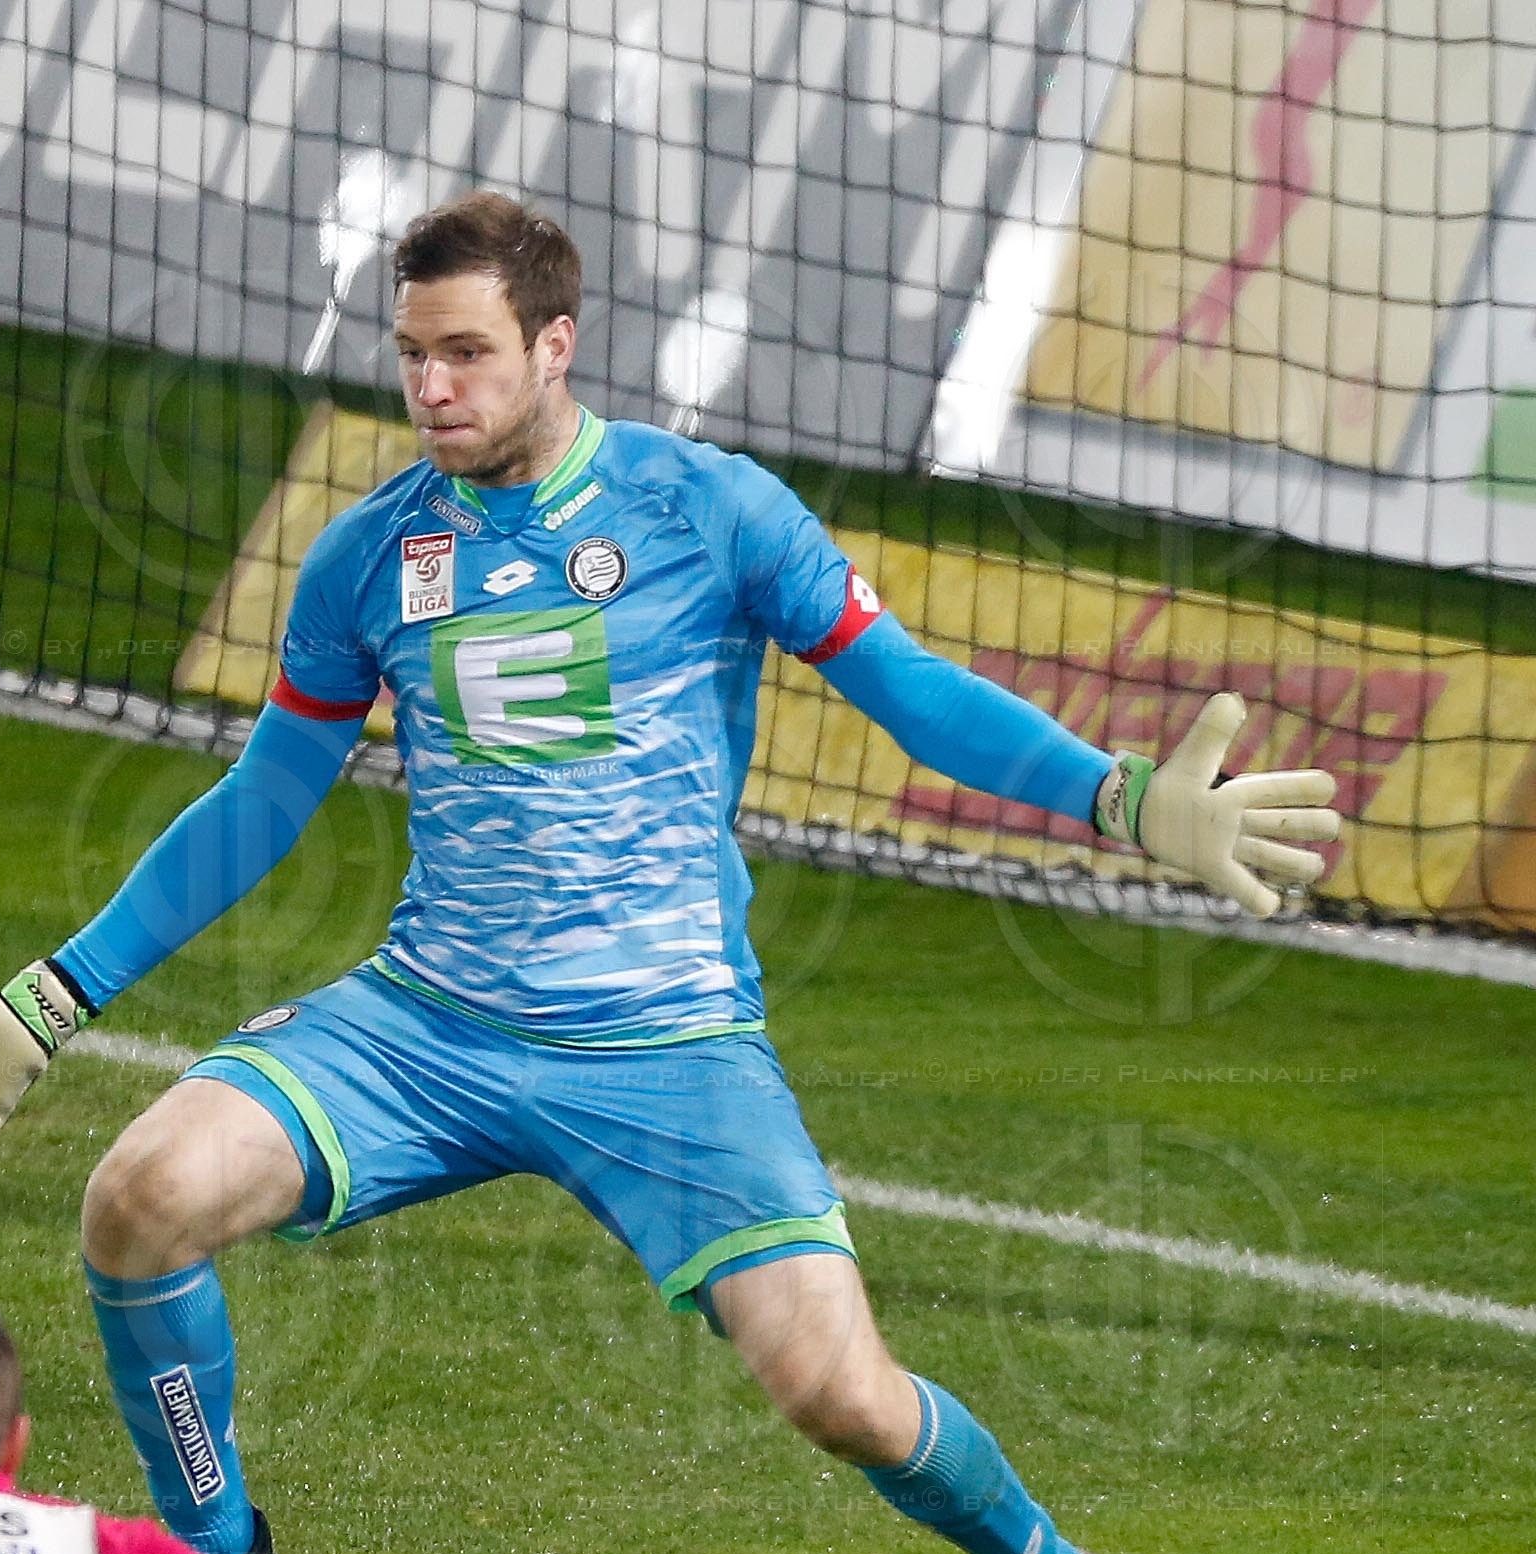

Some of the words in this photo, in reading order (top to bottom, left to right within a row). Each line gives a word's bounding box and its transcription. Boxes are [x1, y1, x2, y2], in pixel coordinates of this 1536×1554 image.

[560, 481, 602, 520] GRAWE
[407, 539, 450, 556] tipico
[409, 595, 449, 614] LIGA
[162, 1377, 219, 1494] PUNTIGAMER
